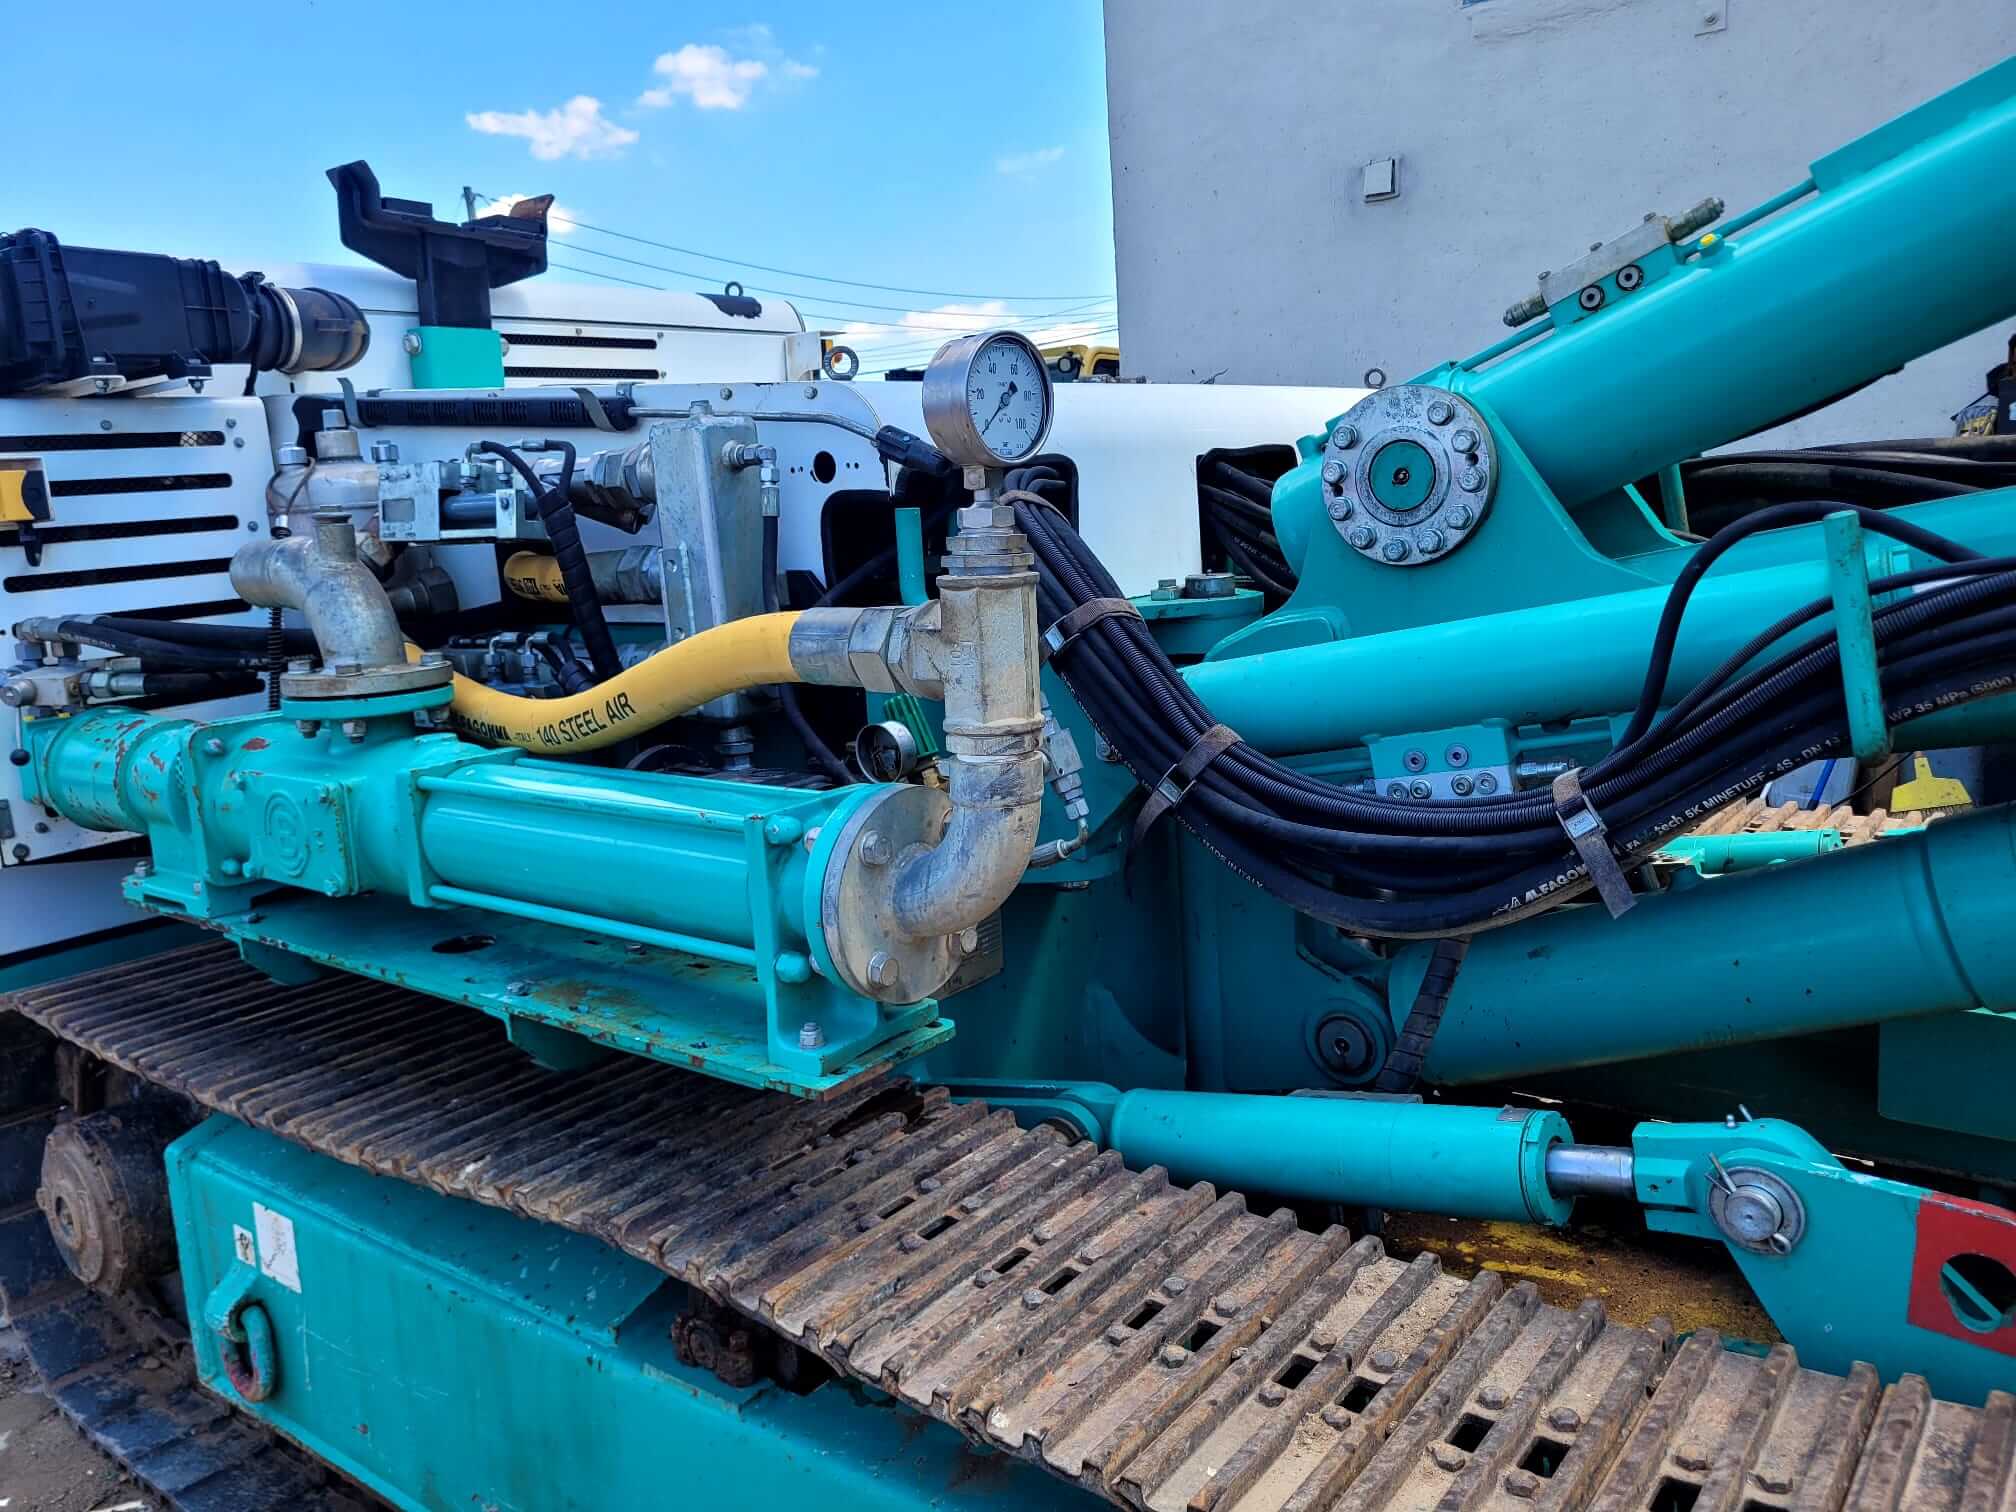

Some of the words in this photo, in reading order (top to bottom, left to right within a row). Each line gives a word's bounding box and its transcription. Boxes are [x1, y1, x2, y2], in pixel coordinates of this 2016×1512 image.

[988, 362, 997, 374] 40
[1010, 364, 1018, 375] 60
[976, 388, 985, 400] 20
[1015, 417, 1026, 430] 100
[536, 724, 561, 747] 140
[559, 709, 608, 742] STEEL
[604, 692, 637, 724] AIR
[1888, 707, 1913, 722] WP
[1702, 771, 1766, 809] MINETUFF
[1776, 758, 1794, 772] 4S
[1801, 744, 1823, 759] DN
